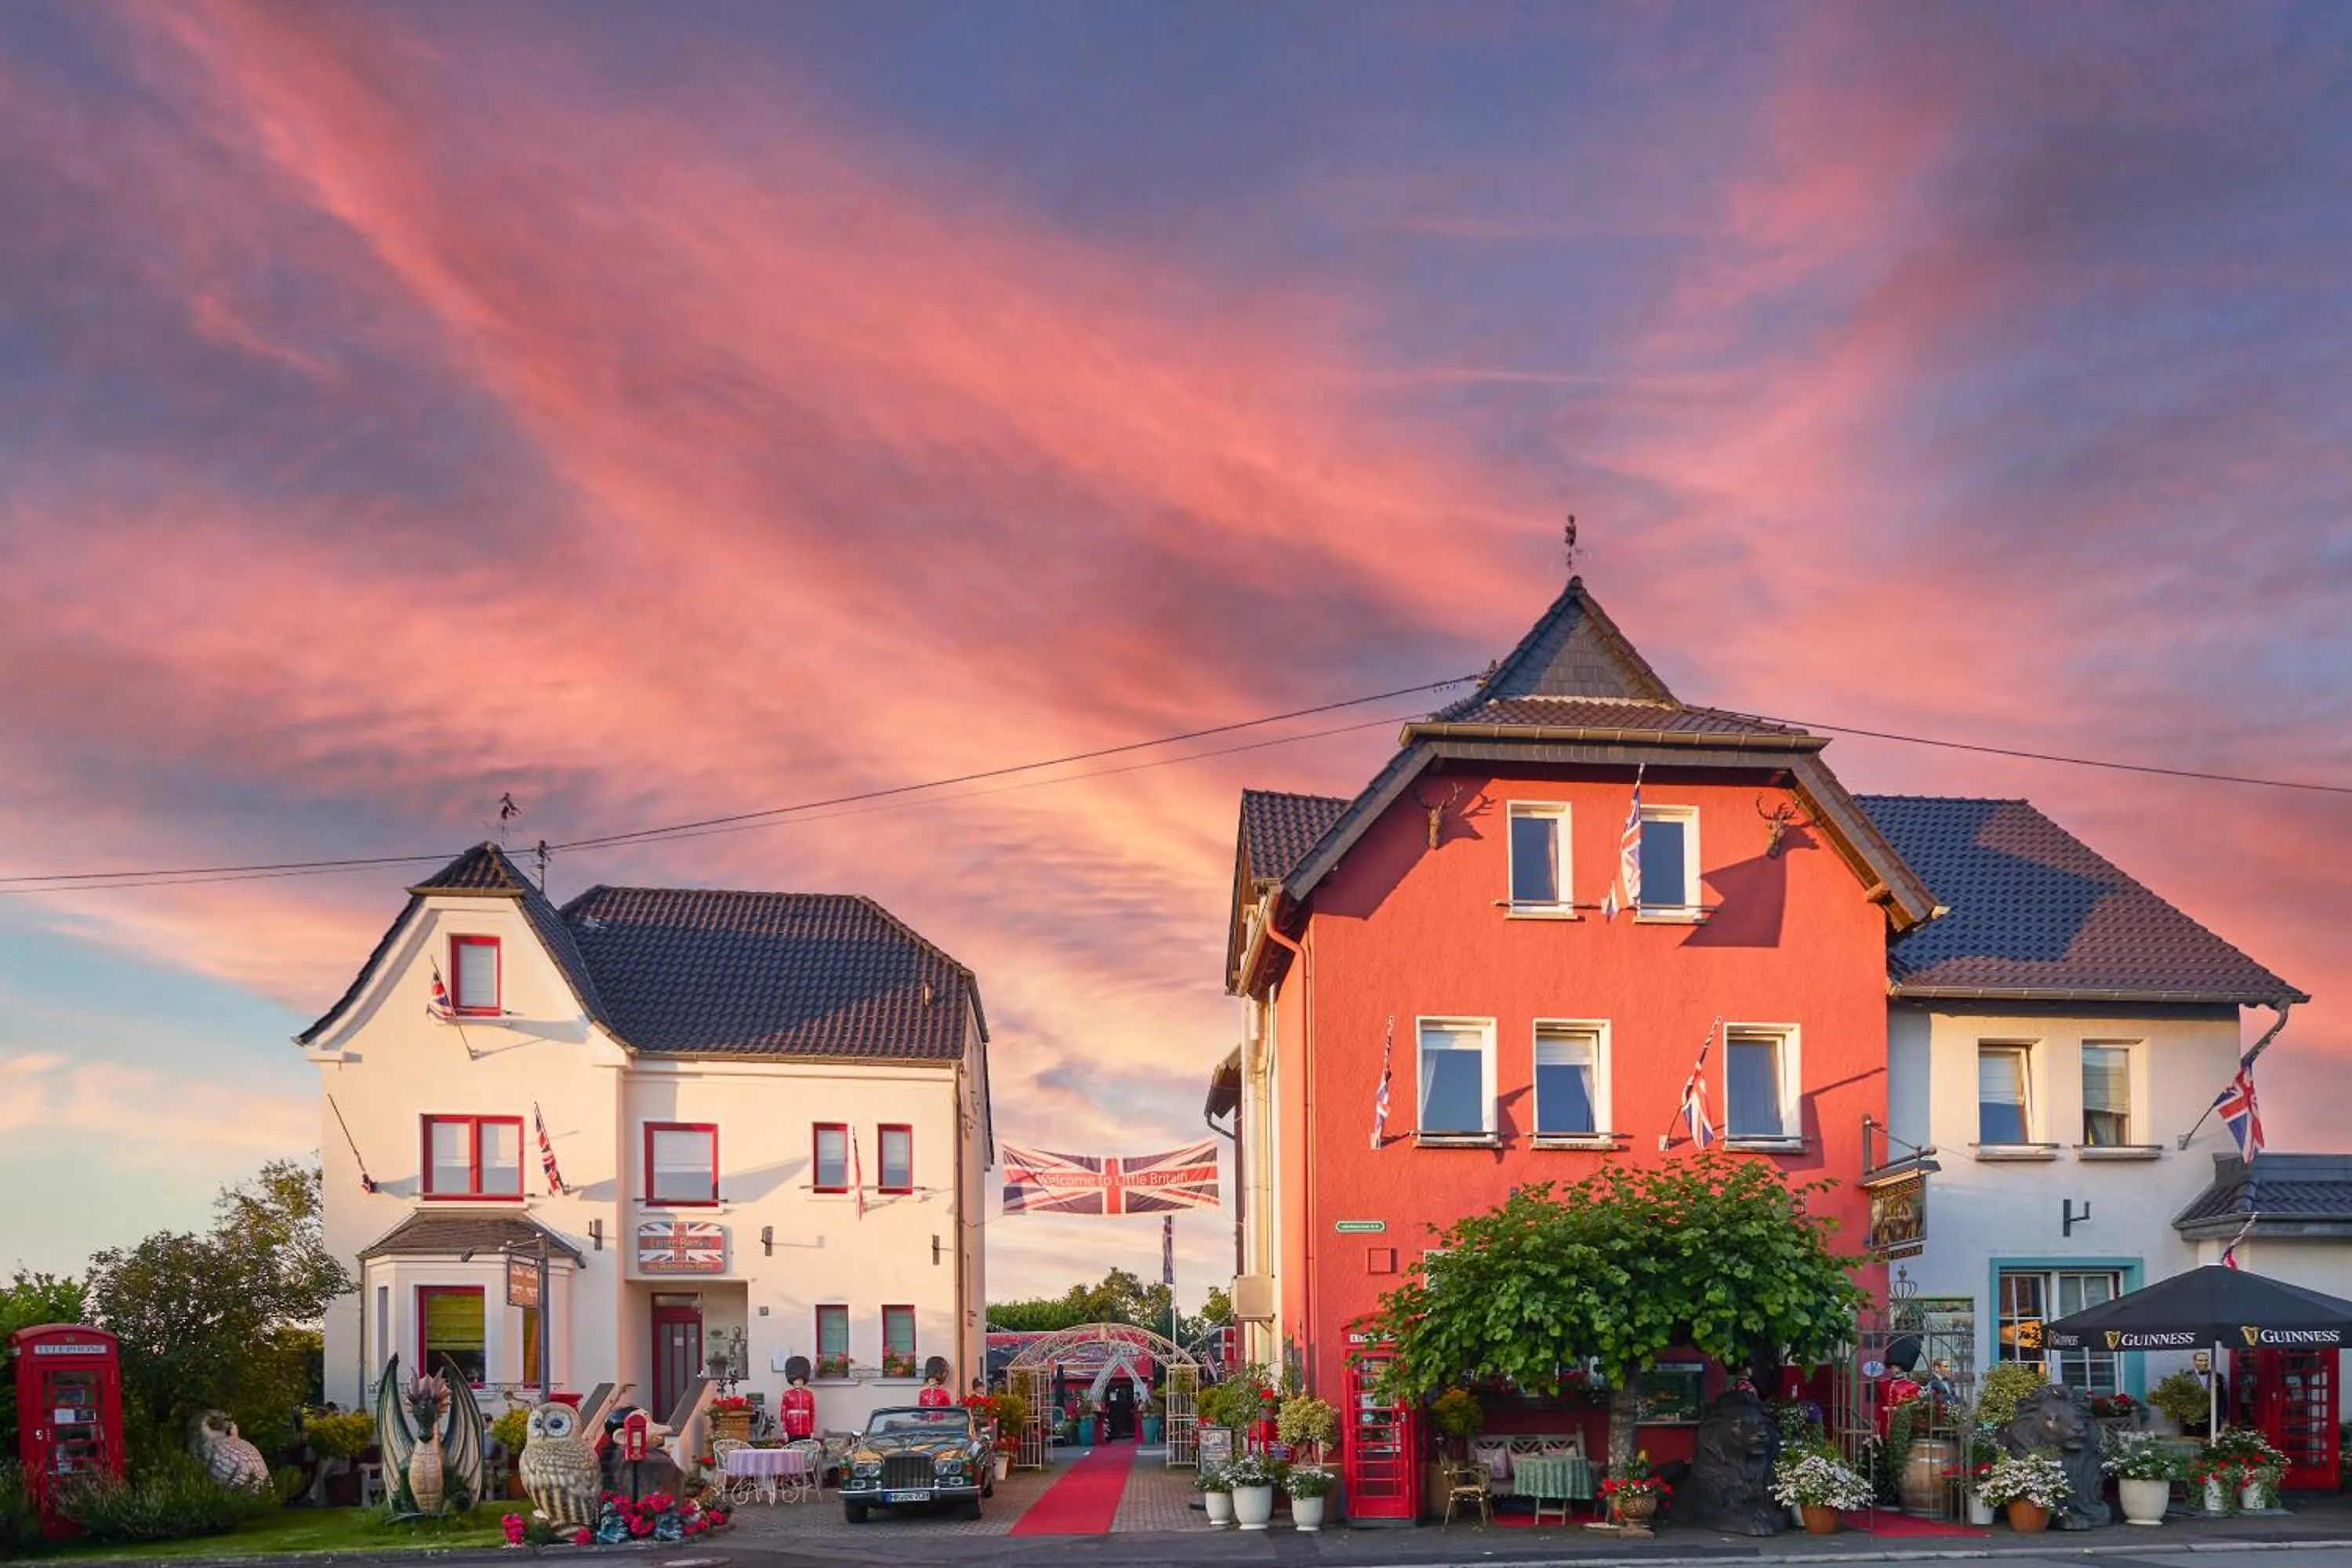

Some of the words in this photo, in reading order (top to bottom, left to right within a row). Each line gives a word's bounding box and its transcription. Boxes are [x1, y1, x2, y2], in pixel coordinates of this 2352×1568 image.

[1037, 1173, 1093, 1186] Welcome
[1098, 1174, 1112, 1186] to
[1116, 1173, 1145, 1186] Little
[2121, 1332, 2195, 1346] GUINNESS
[2260, 1329, 2340, 1343] GUINNESS
